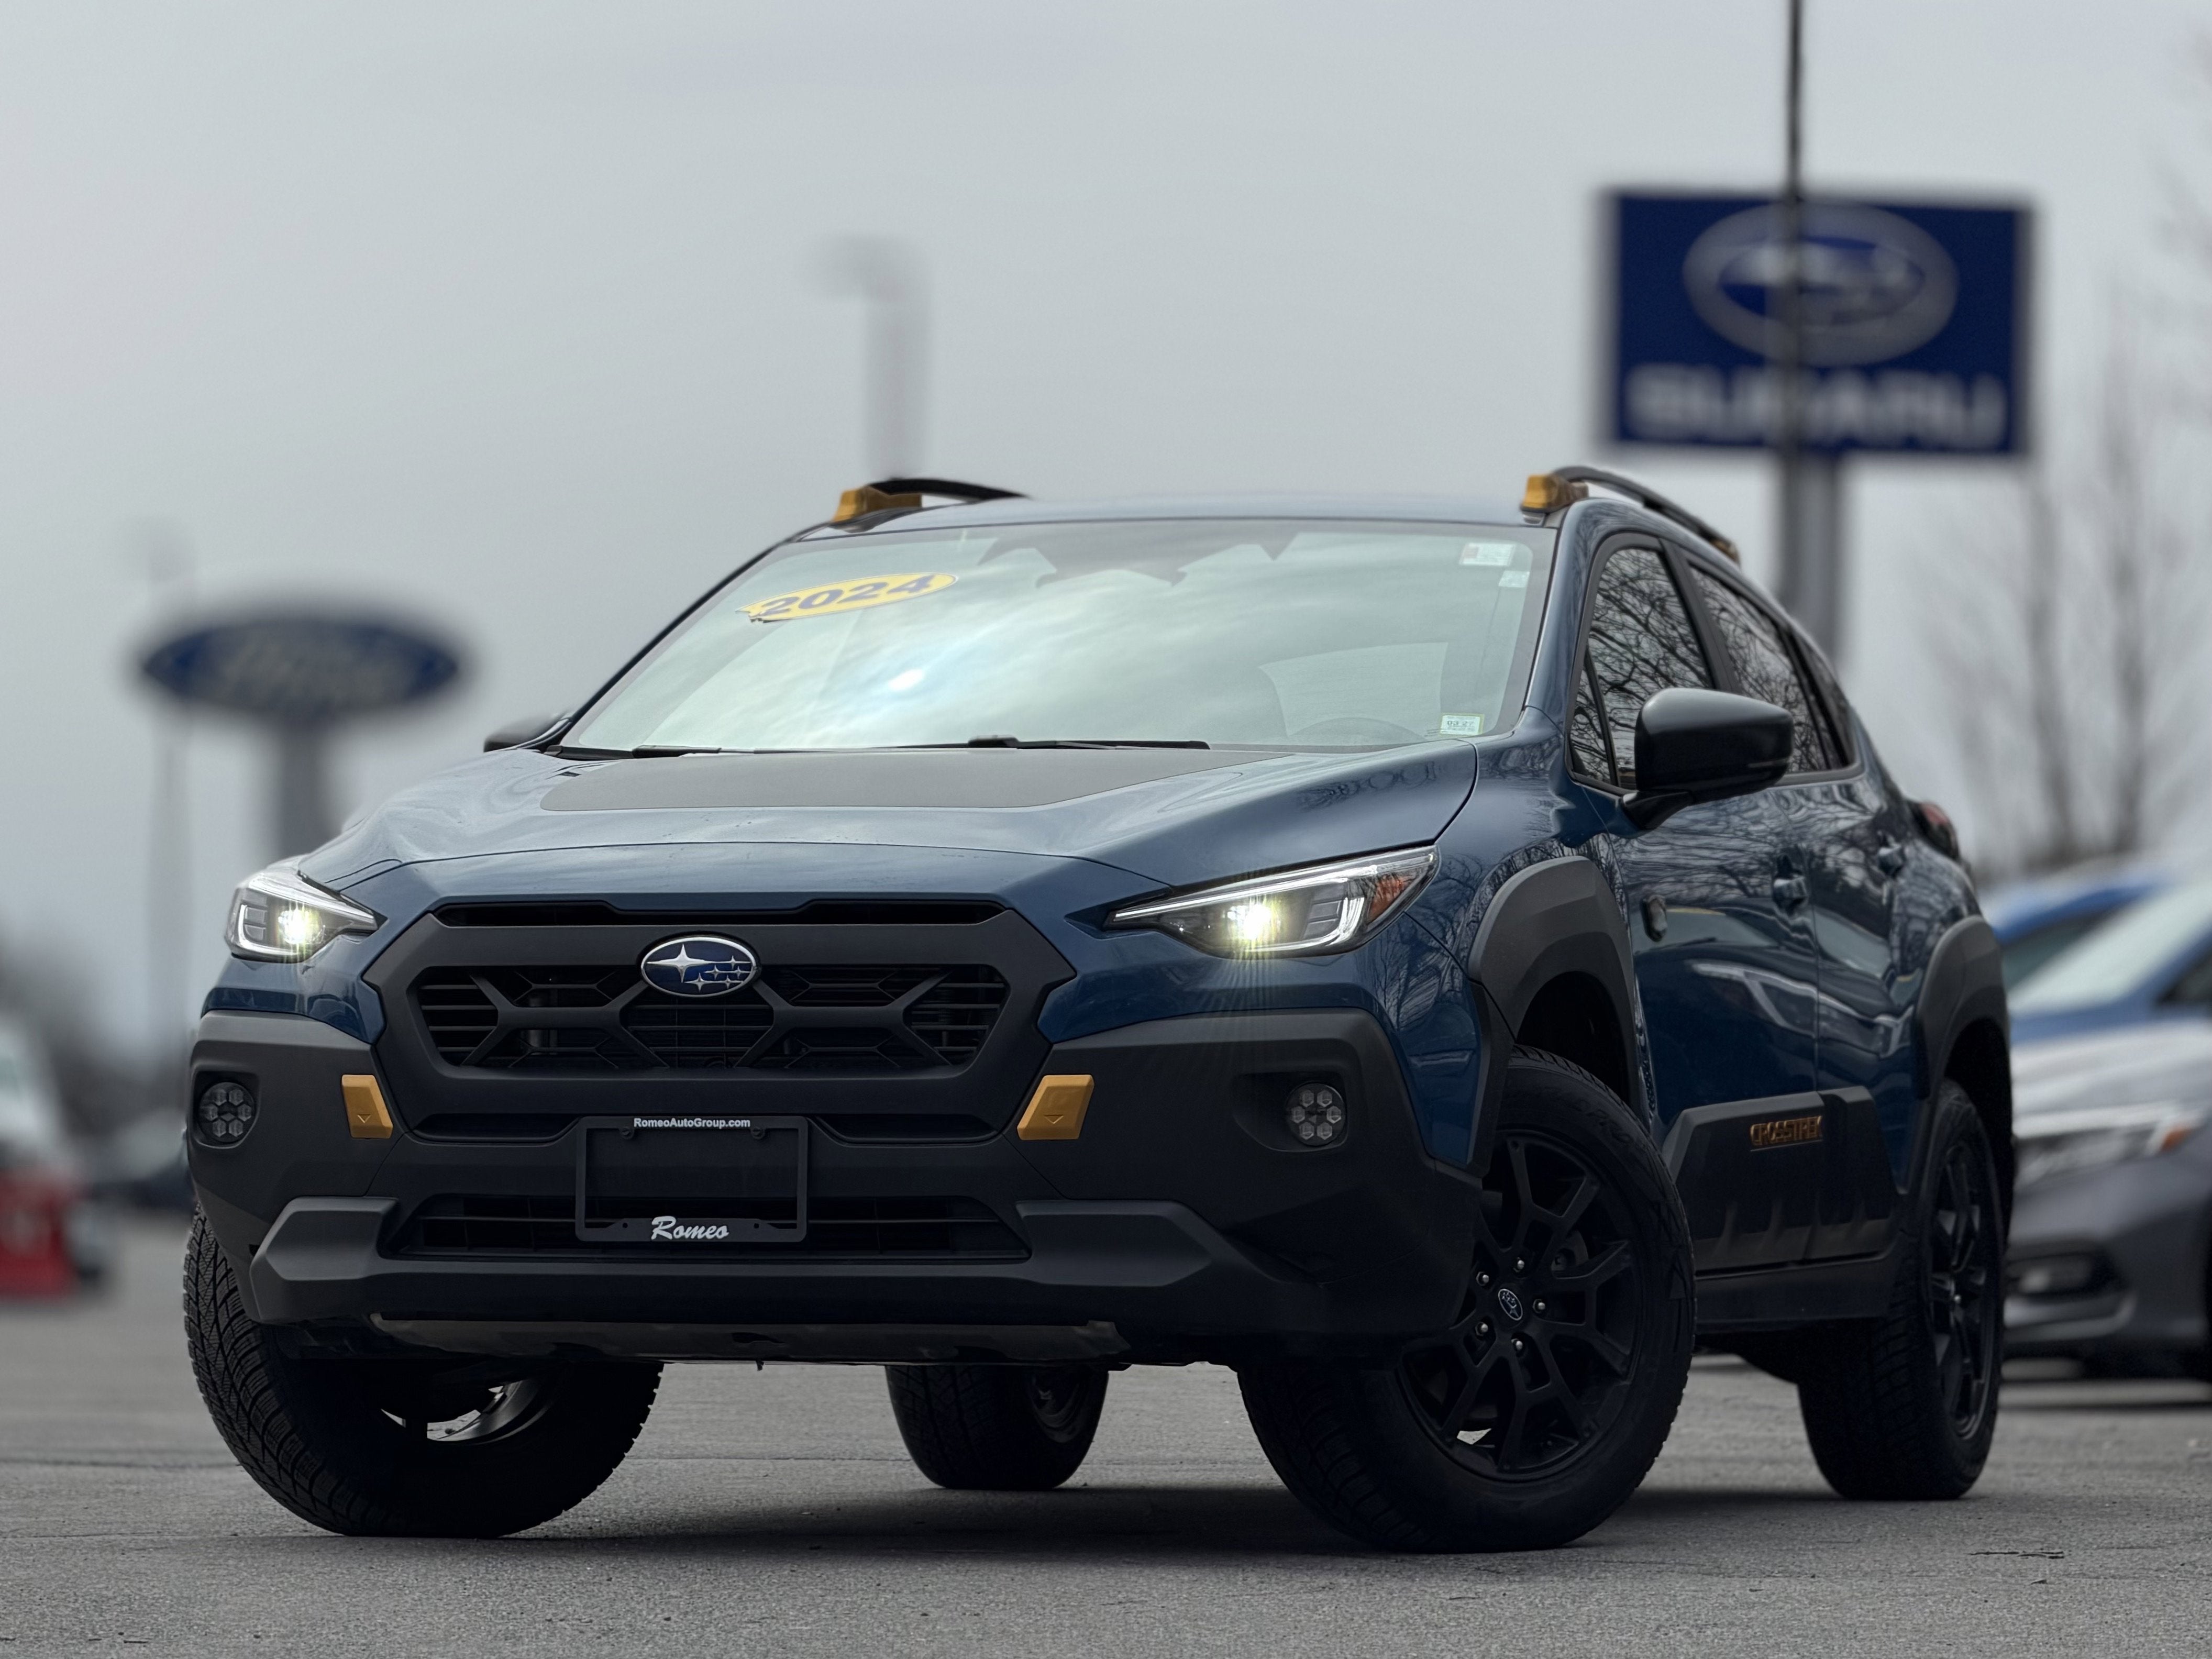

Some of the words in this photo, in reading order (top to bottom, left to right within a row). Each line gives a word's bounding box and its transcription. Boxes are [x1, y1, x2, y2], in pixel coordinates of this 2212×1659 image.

[759, 574, 936, 617] 2024
[633, 1117, 750, 1129] RomeoAutoGroup.com
[650, 1215, 729, 1240] Romeo
